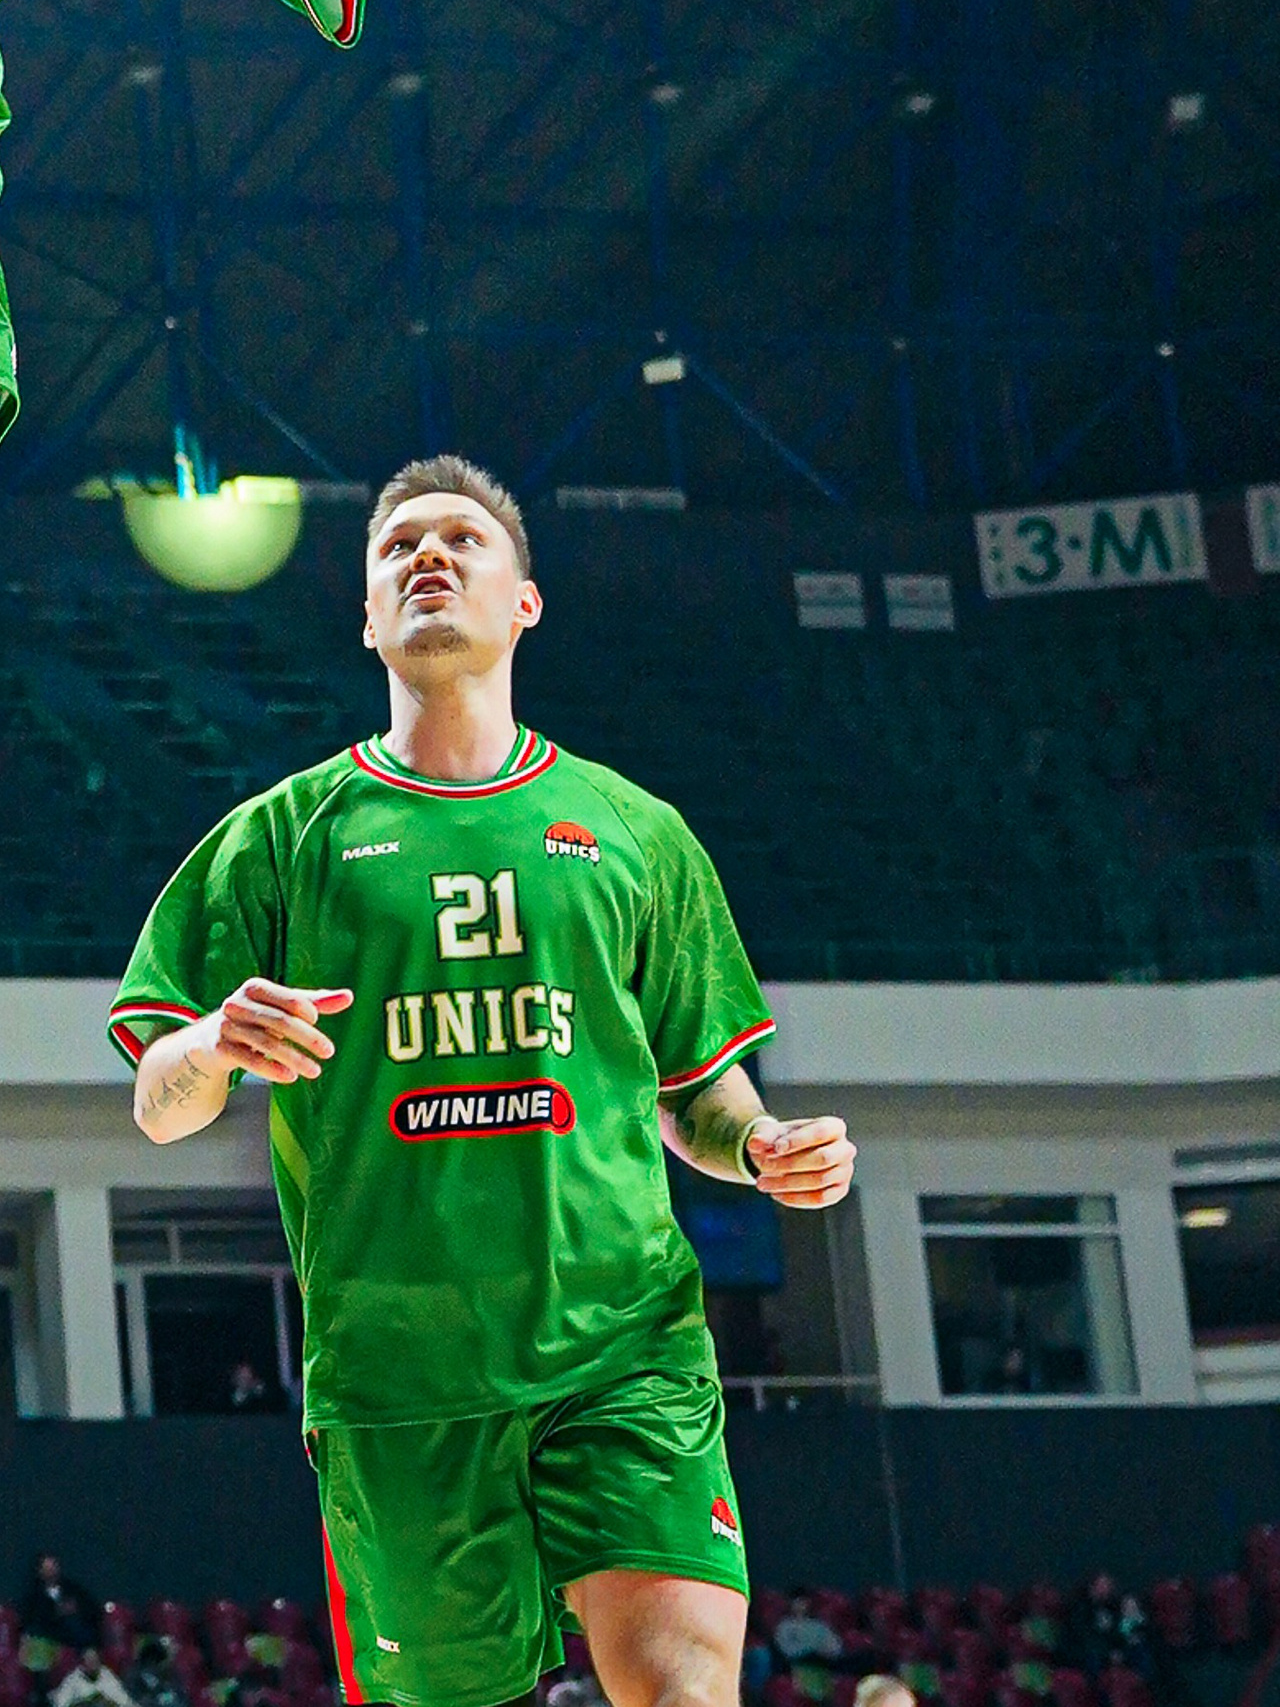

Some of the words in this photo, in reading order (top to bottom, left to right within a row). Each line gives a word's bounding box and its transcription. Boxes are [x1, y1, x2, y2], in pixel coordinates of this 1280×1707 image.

[341, 841, 401, 862] MAXX
[545, 839, 601, 863] UNICS
[429, 869, 524, 960] 21
[385, 982, 575, 1063] UNICS
[406, 1090, 552, 1131] WINLINE
